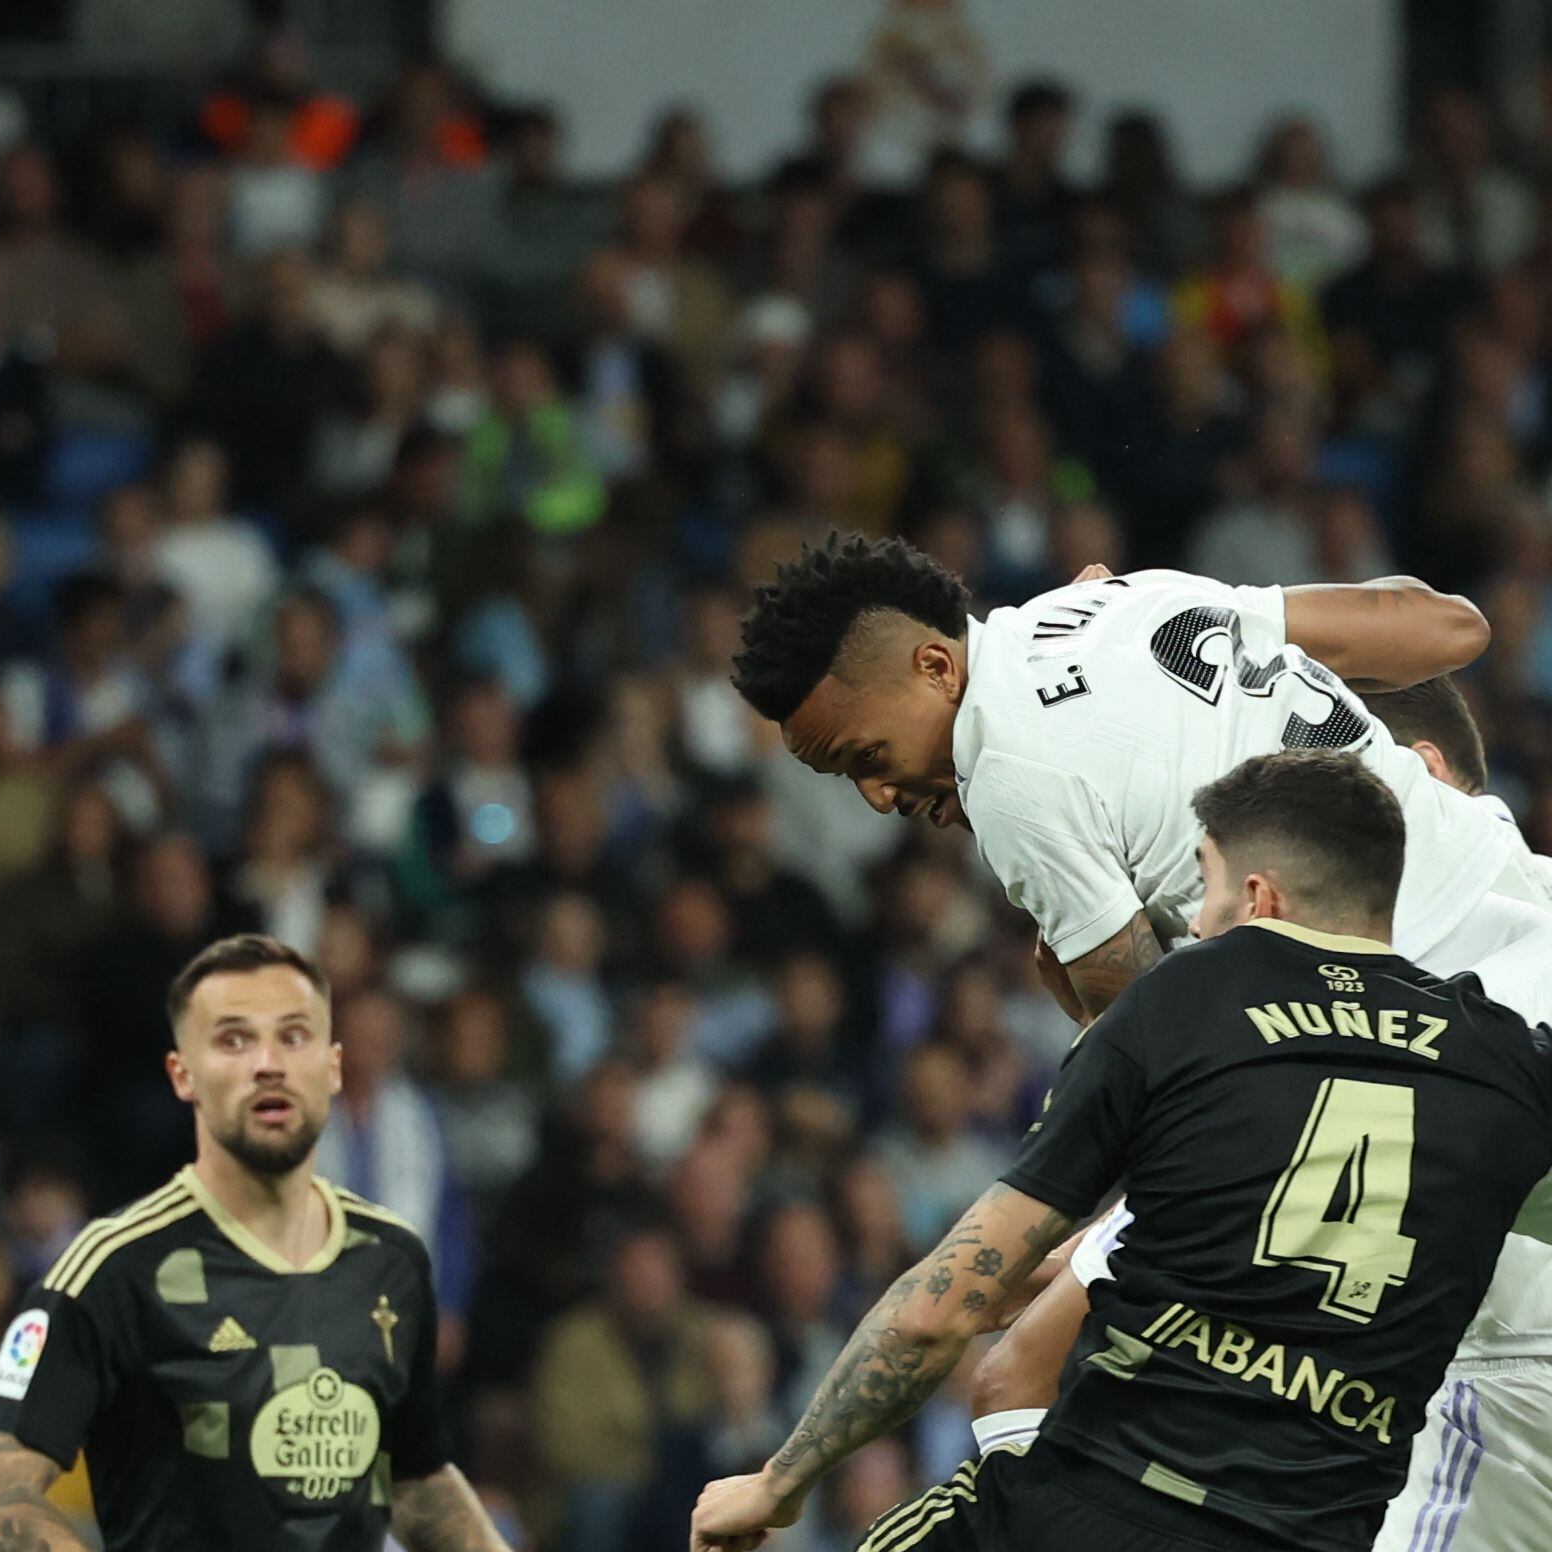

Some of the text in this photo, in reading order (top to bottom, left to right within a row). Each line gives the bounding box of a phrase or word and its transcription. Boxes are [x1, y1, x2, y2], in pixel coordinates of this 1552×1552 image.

[1036, 663, 1092, 708] E.
[1150, 606, 1375, 752] 3
[1245, 1001, 1448, 1060] NUÑEZ
[1325, 979, 1365, 993] 1923
[1252, 1077, 1417, 1324] 4
[1146, 1302, 1397, 1444] ABANCA
